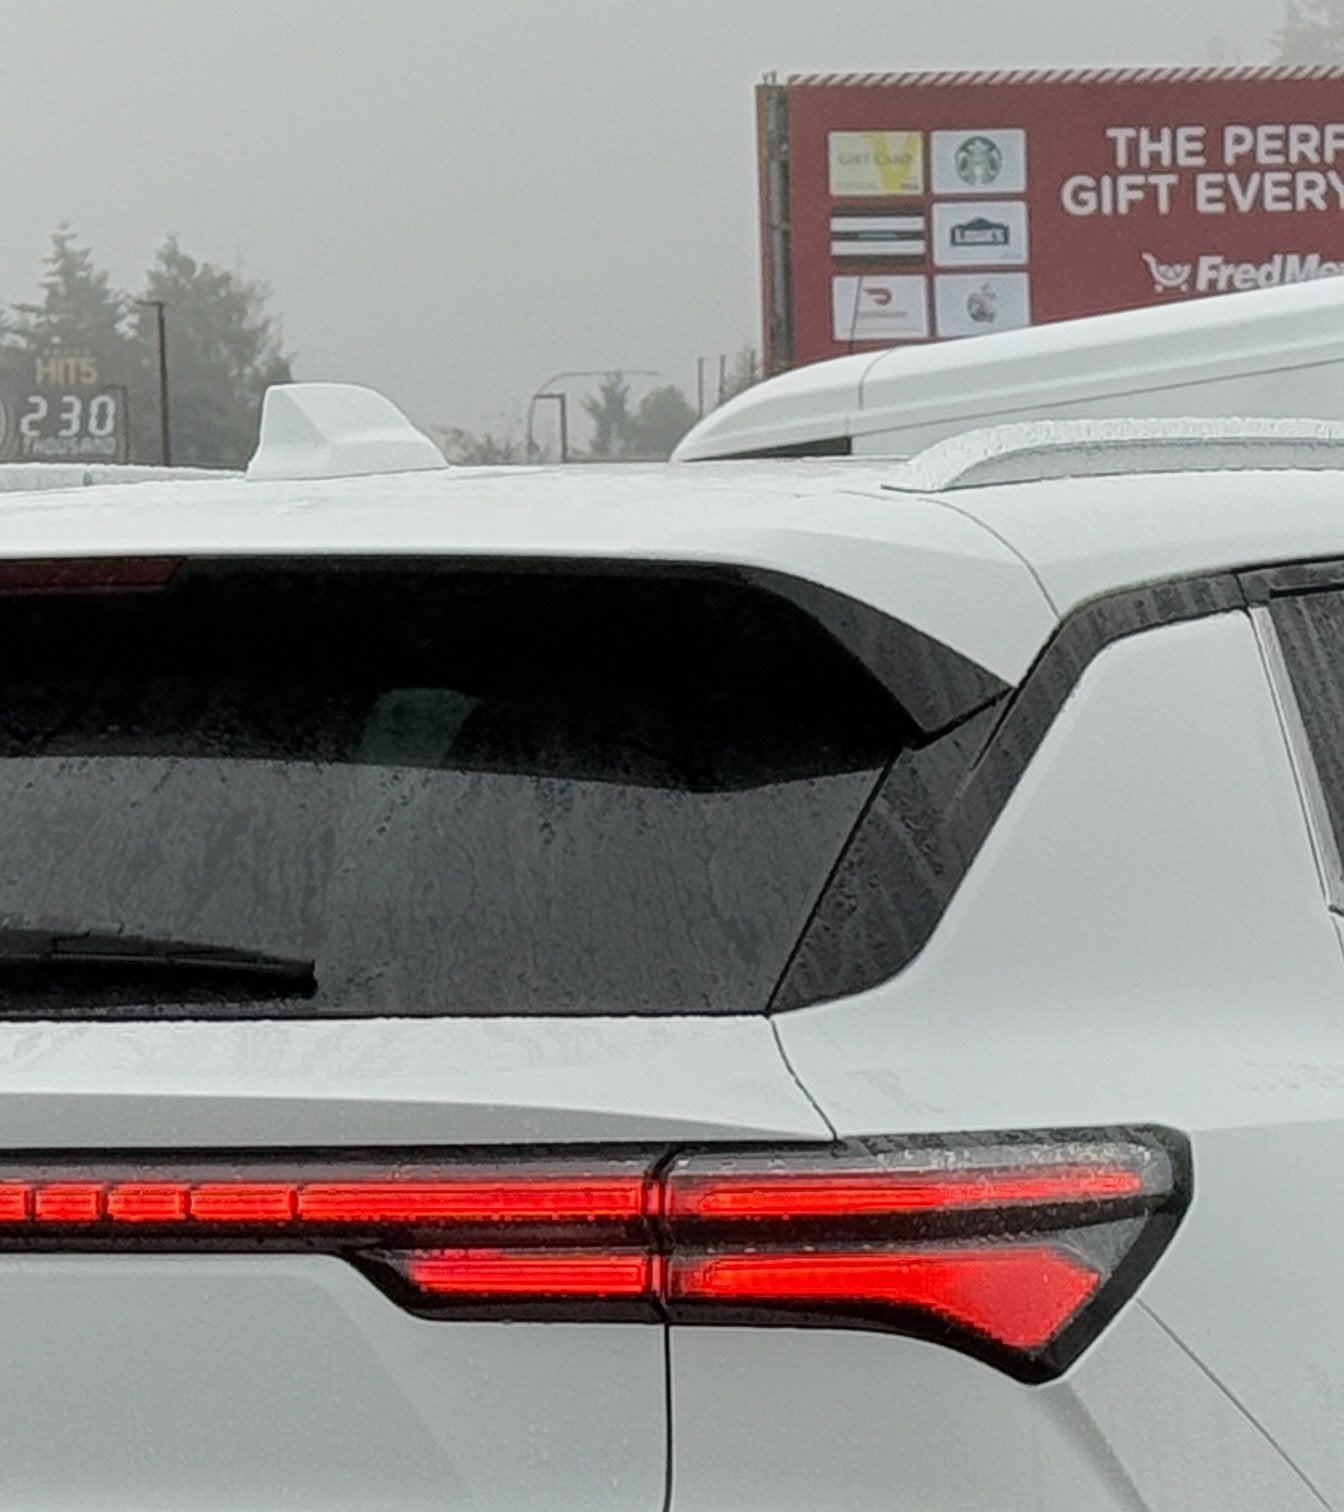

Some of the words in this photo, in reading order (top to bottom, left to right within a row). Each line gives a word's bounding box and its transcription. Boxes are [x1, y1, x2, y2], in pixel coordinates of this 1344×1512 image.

[1106, 126, 1205, 168] THE
[1061, 173, 1179, 216] GIFT
[20, 395, 116, 437] 230
